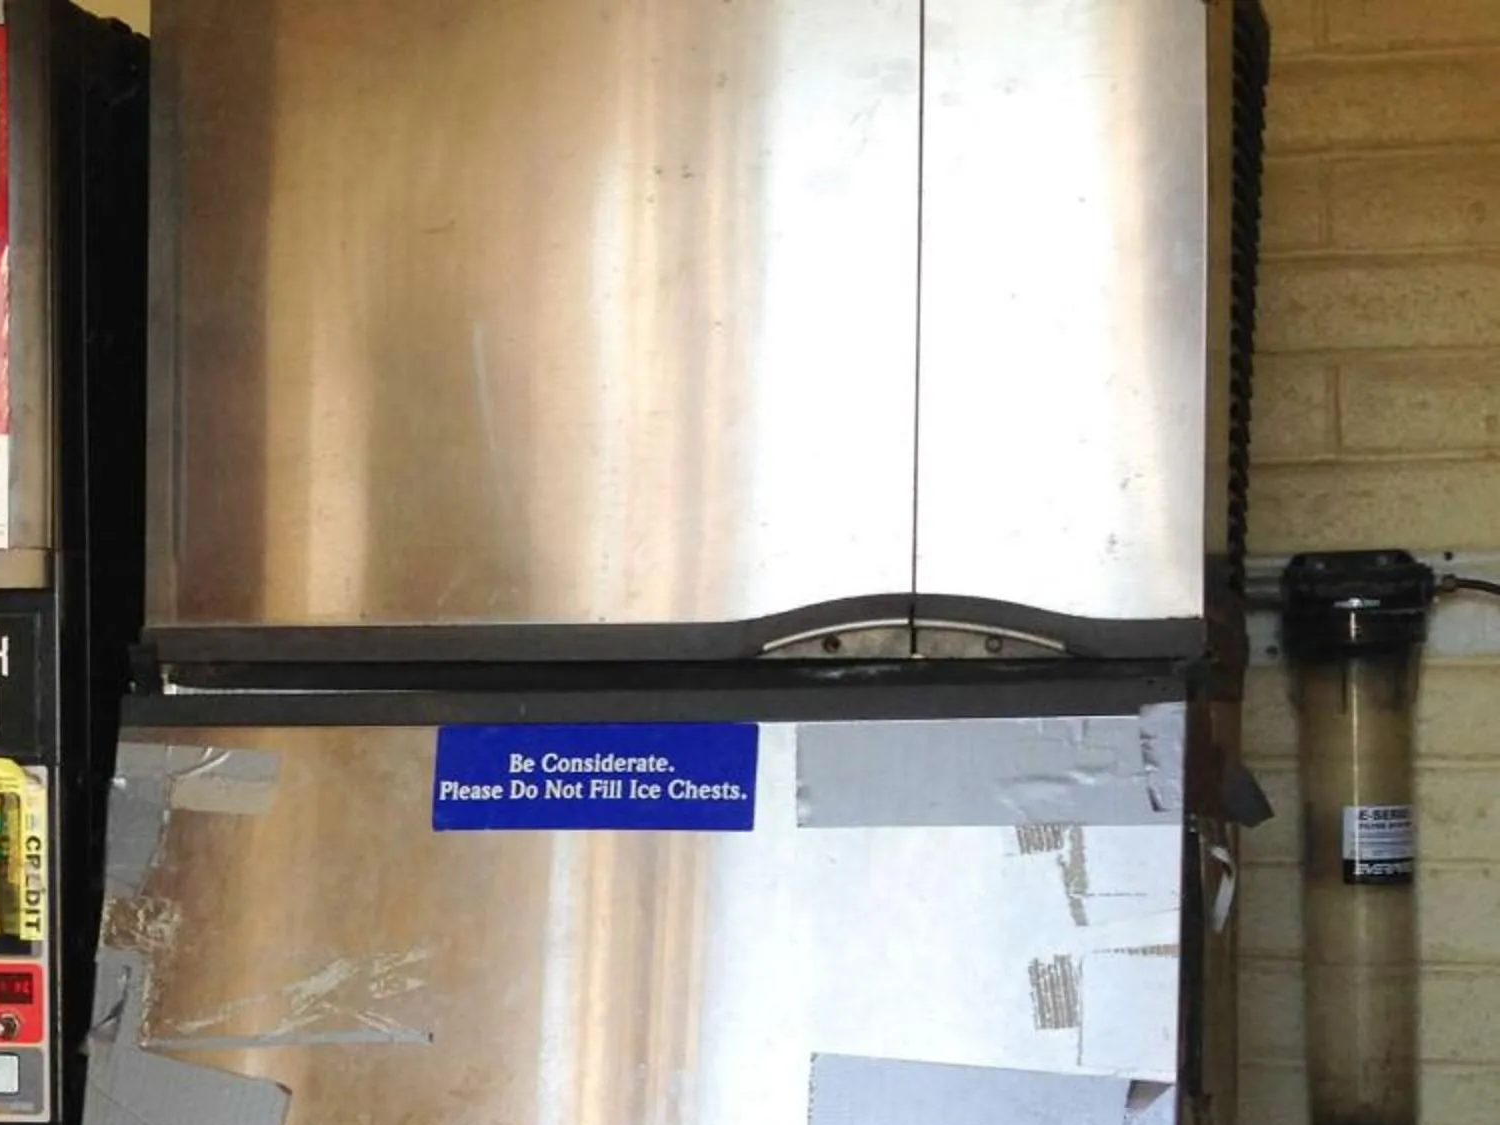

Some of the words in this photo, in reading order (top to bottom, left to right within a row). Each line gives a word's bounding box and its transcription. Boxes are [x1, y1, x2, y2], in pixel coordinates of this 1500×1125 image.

[509, 753, 535, 773] Be
[541, 753, 675, 773] Considerate.
[439, 781, 503, 800] Please
[509, 780, 538, 799] Do
[544, 780, 583, 799] Not
[589, 780, 622, 799] Fill
[630, 780, 661, 799] Ice
[668, 779, 747, 800] Chests.
